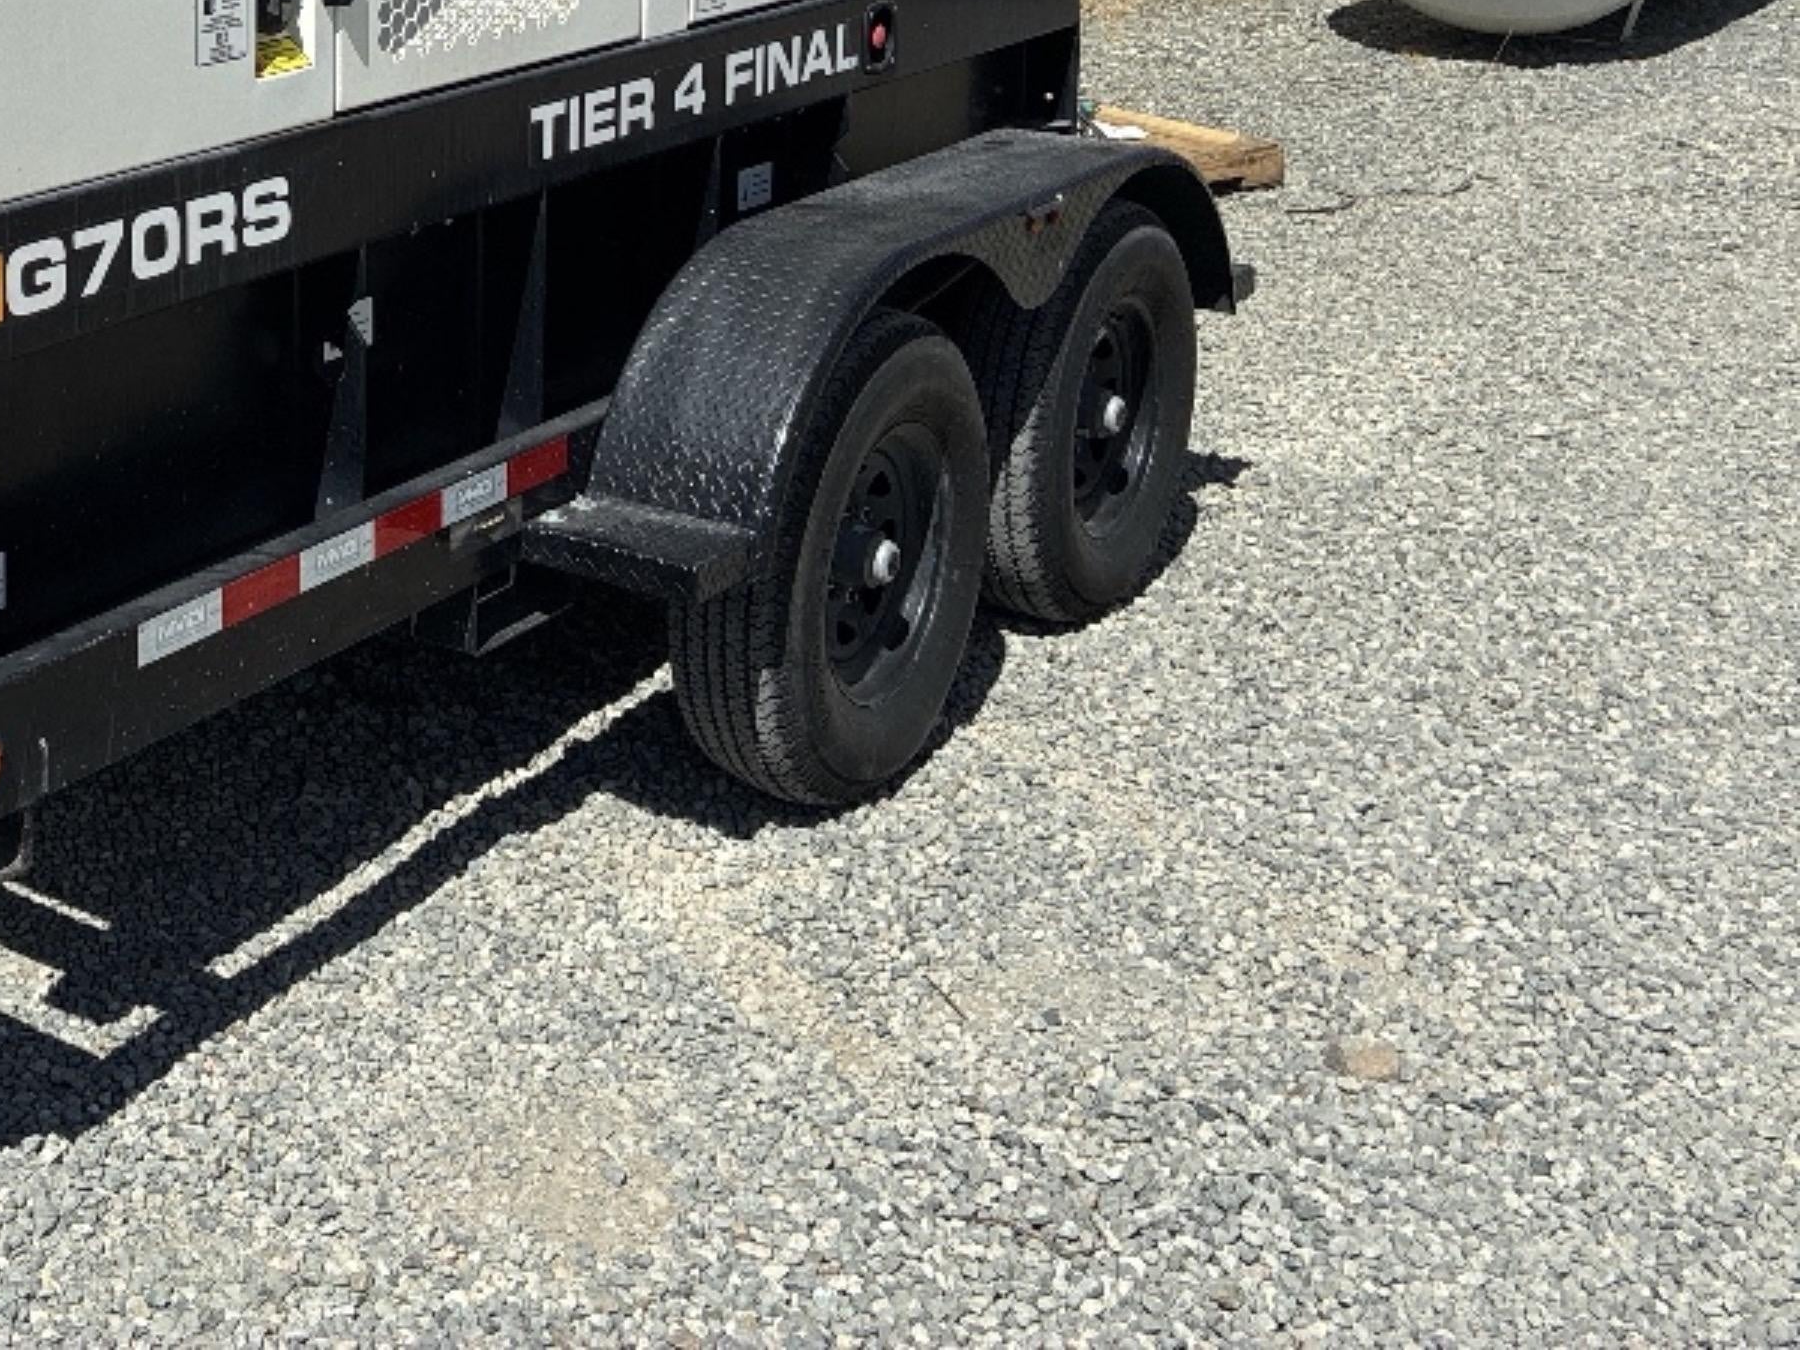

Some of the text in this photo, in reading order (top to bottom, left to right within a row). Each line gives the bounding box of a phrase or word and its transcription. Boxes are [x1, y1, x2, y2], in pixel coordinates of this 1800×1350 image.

[530, 23, 860, 161] TIER 4 FINAL
[5, 175, 293, 316] G70RS
